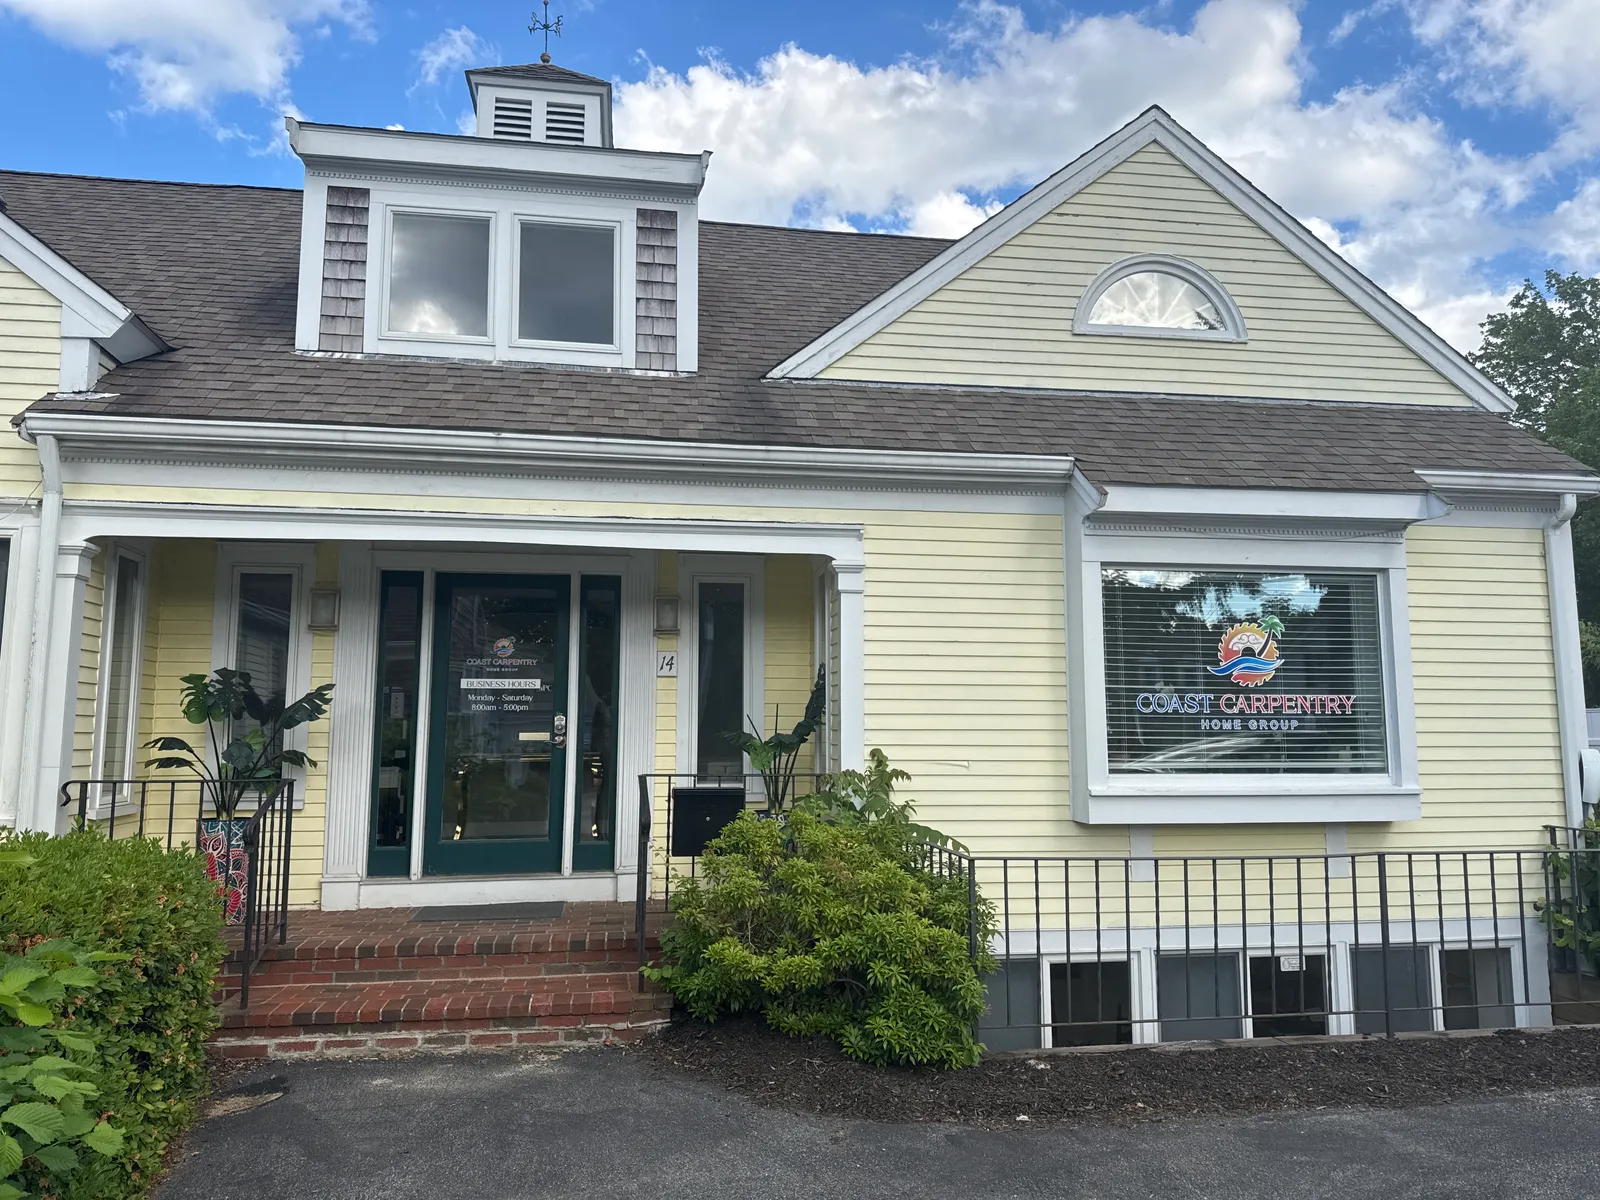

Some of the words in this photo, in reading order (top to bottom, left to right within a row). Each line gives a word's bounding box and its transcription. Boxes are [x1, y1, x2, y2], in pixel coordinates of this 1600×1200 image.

[466, 658, 491, 666] COAST
[492, 658, 538, 666] CARPENTRY
[659, 655, 675, 672] 14
[466, 680, 506, 688] BUSINESS
[507, 680, 537, 688] HOURS
[467, 694, 496, 702] Monday
[501, 694, 534, 702] Saturday
[471, 703, 497, 711] 8:00am
[503, 703, 529, 712] 5:00pm
[1136, 693, 1214, 714] COAST
[1219, 694, 1357, 714] CARPENTRY
[1201, 719, 1242, 730] HOME
[1248, 719, 1299, 730] GROUP
